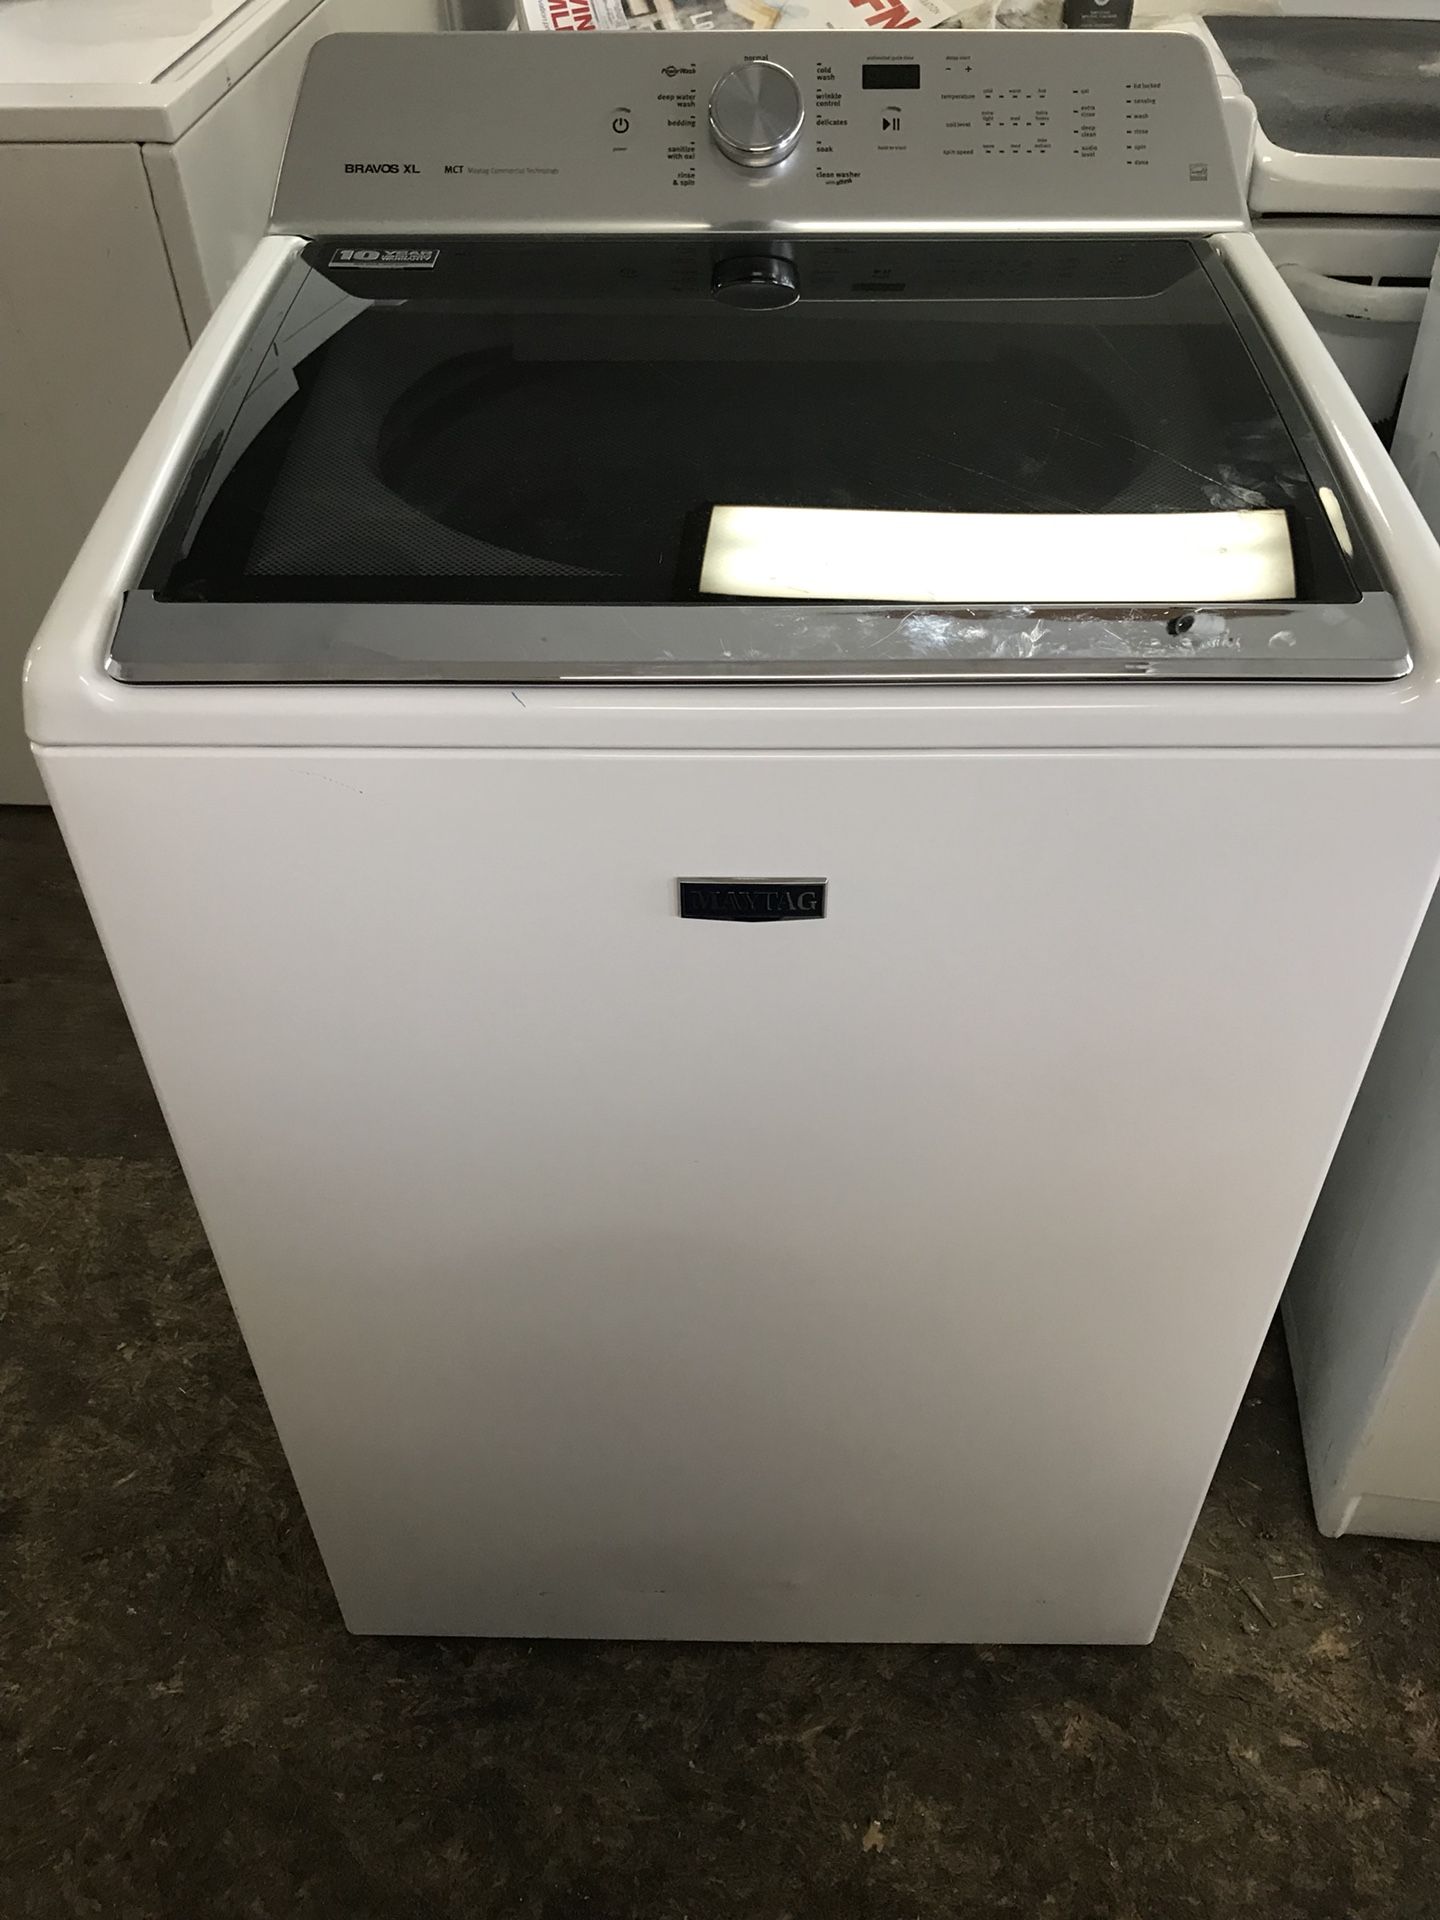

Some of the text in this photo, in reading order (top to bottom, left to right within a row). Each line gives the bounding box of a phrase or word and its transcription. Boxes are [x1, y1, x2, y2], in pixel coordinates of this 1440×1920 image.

[345, 164, 420, 173] BRAVOS XL
[340, 249, 381, 261] 10
[688, 891, 818, 911] MAYTAG
